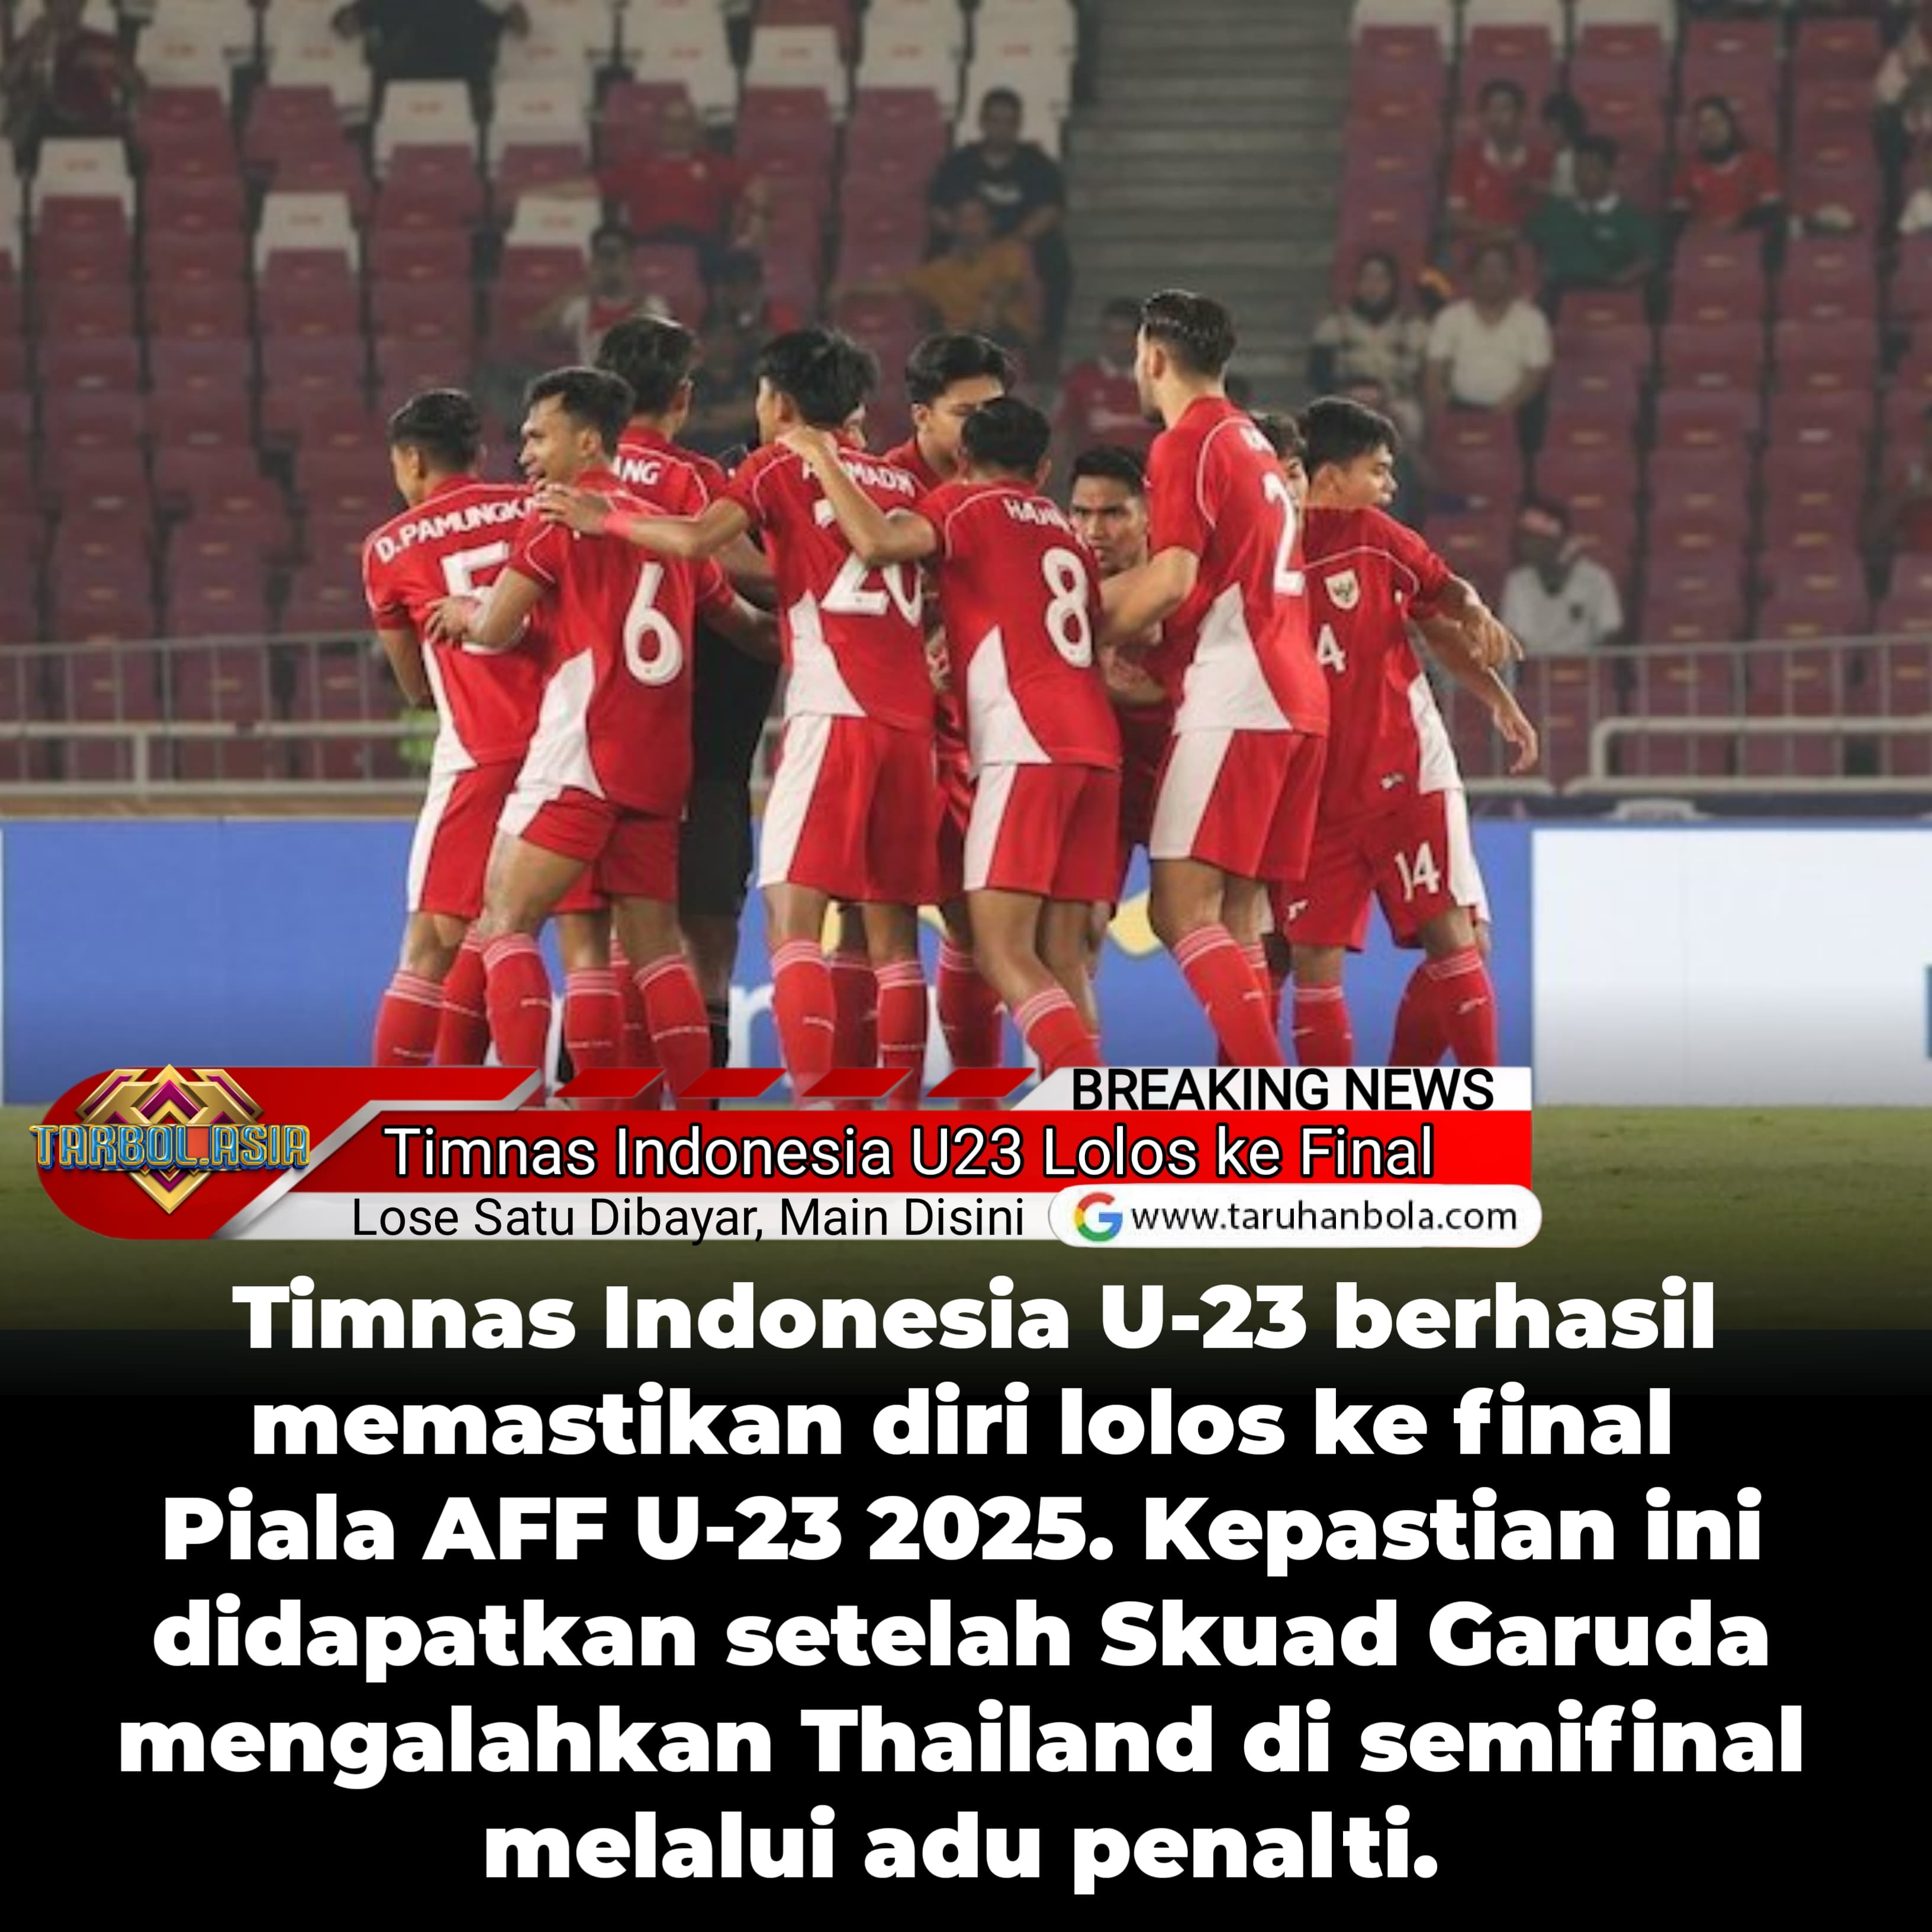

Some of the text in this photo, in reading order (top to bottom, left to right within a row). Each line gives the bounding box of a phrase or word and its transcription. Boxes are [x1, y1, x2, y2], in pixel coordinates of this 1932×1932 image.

[624, 561, 683, 685] 6
[1042, 547, 1092, 668] 8
[1394, 840, 1441, 902] 14
